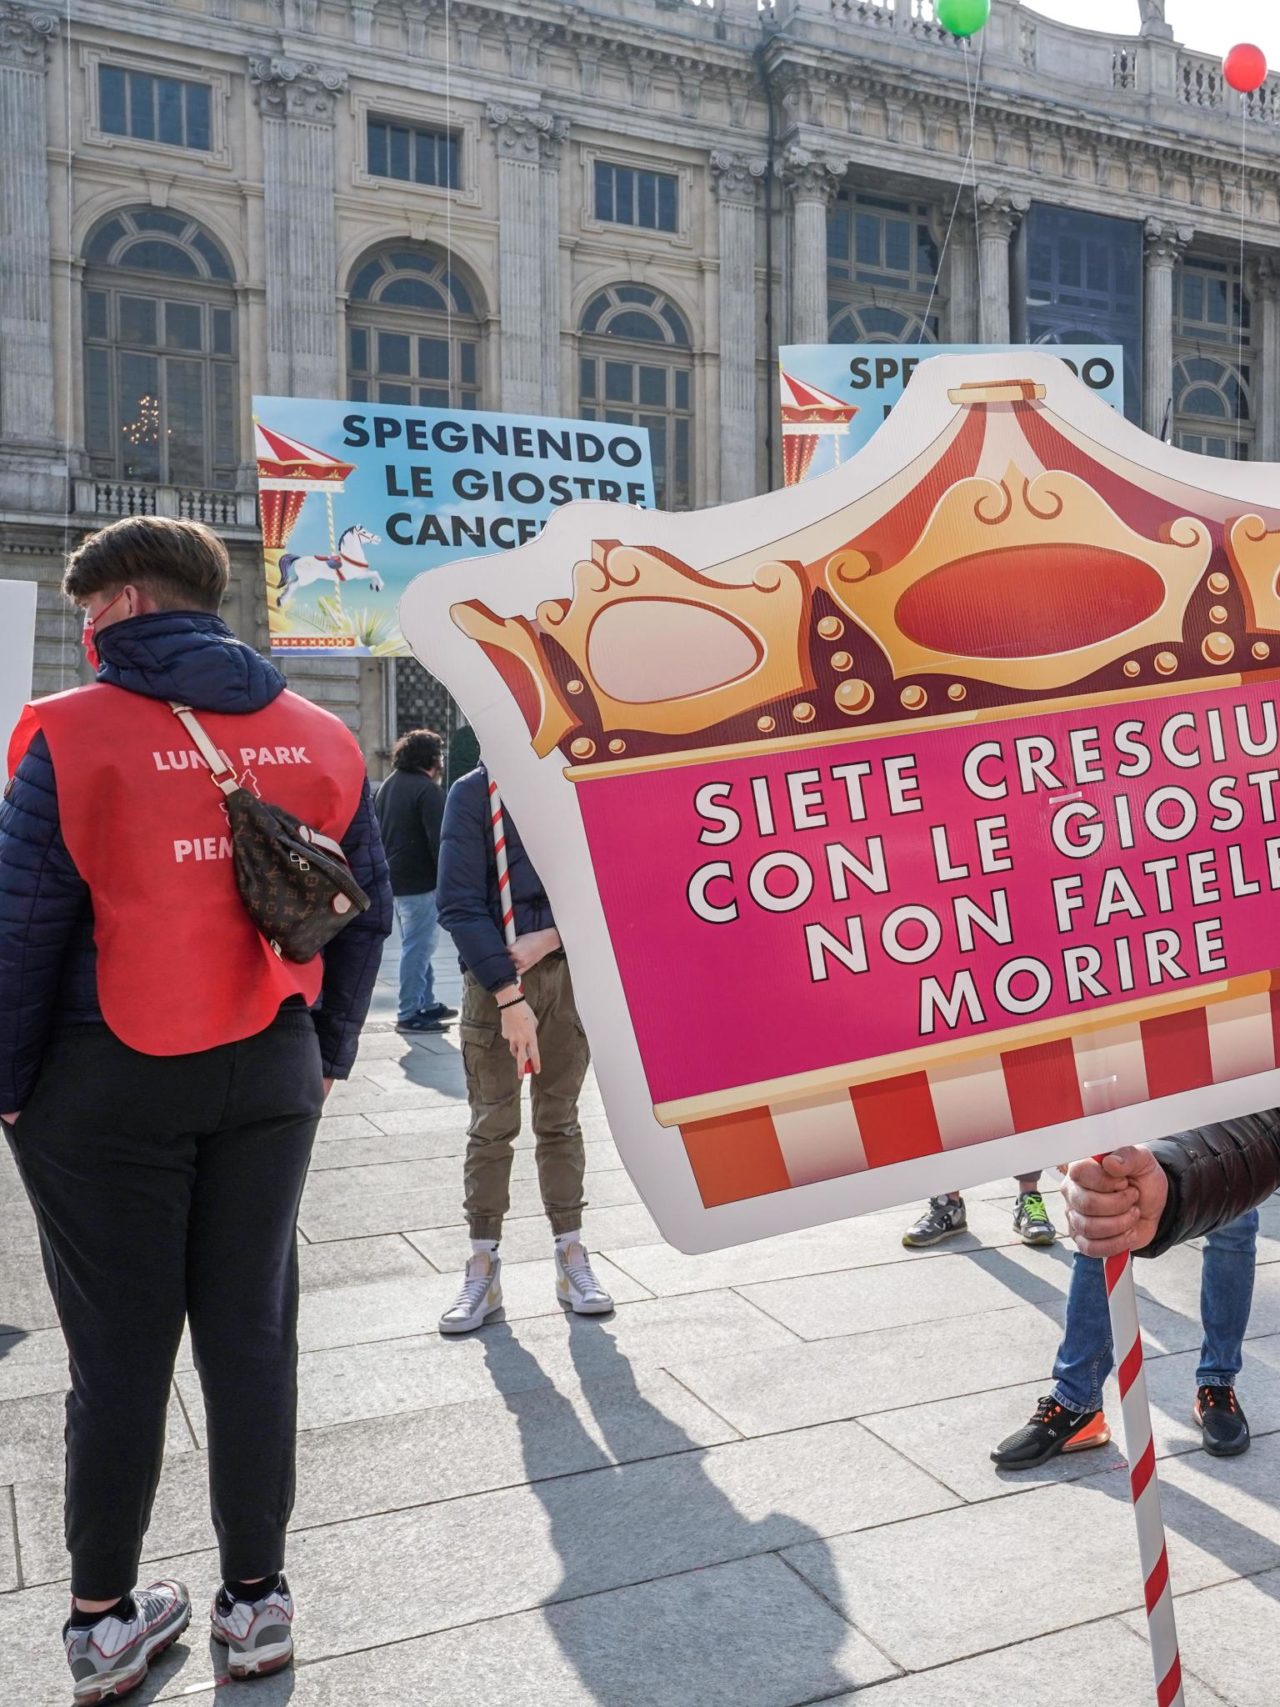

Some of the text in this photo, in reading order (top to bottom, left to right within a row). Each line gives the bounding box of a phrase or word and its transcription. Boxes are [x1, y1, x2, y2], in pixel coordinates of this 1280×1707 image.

[342, 414, 642, 467] SPEGNENDO
[385, 464, 647, 509] LE GIOSTRE
[385, 512, 547, 550] CANCE
[239, 747, 312, 766] PARK
[694, 753, 925, 847] SIETE
[687, 836, 890, 925] CON
[931, 815, 1013, 884] LE
[804, 888, 1013, 984] NON
[918, 917, 1228, 1037] MORIRE
